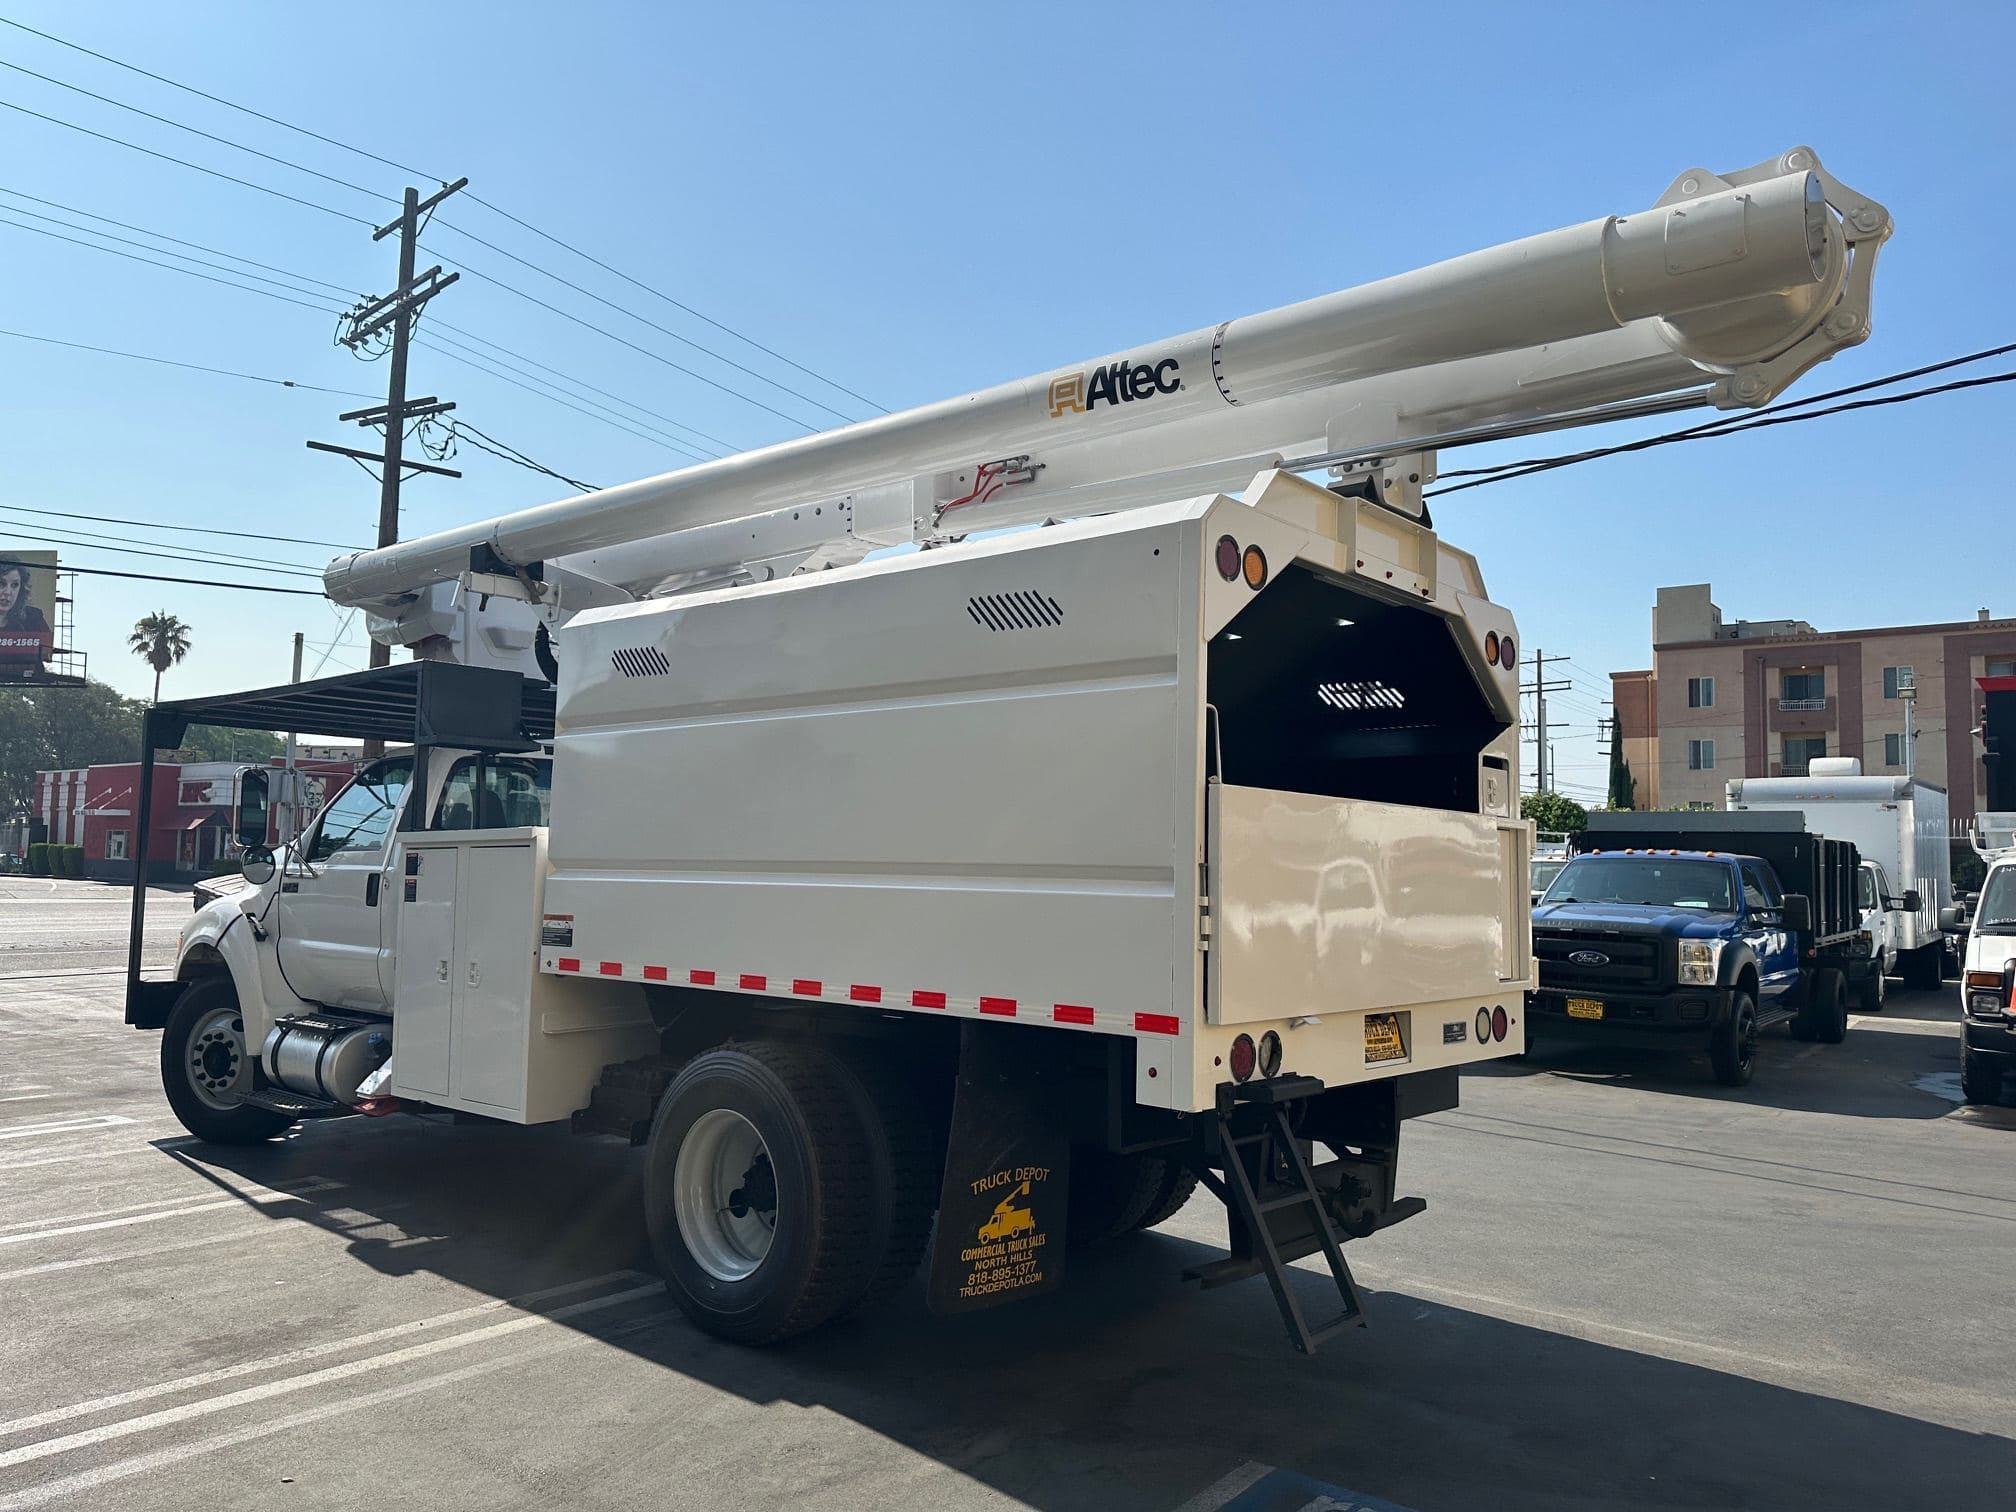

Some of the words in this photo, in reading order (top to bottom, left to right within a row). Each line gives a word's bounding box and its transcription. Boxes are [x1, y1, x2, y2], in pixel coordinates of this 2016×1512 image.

[1086, 358, 1181, 410] Altec
[971, 1170, 1012, 1195] TRUCK
[1015, 1167, 1050, 1182] DEPOT
[961, 1242, 1006, 1262] COMMERCIAL
[1007, 1237, 1028, 1253] TRUCK
[1028, 1233, 1046, 1249] SALES
[974, 1255, 1008, 1271] NORTH
[1010, 1249, 1033, 1264] HILLS
[959, 1271, 1042, 1298] TRUCKDEPOTLA.COM
[967, 1260, 1037, 1286] 818-895-1377
